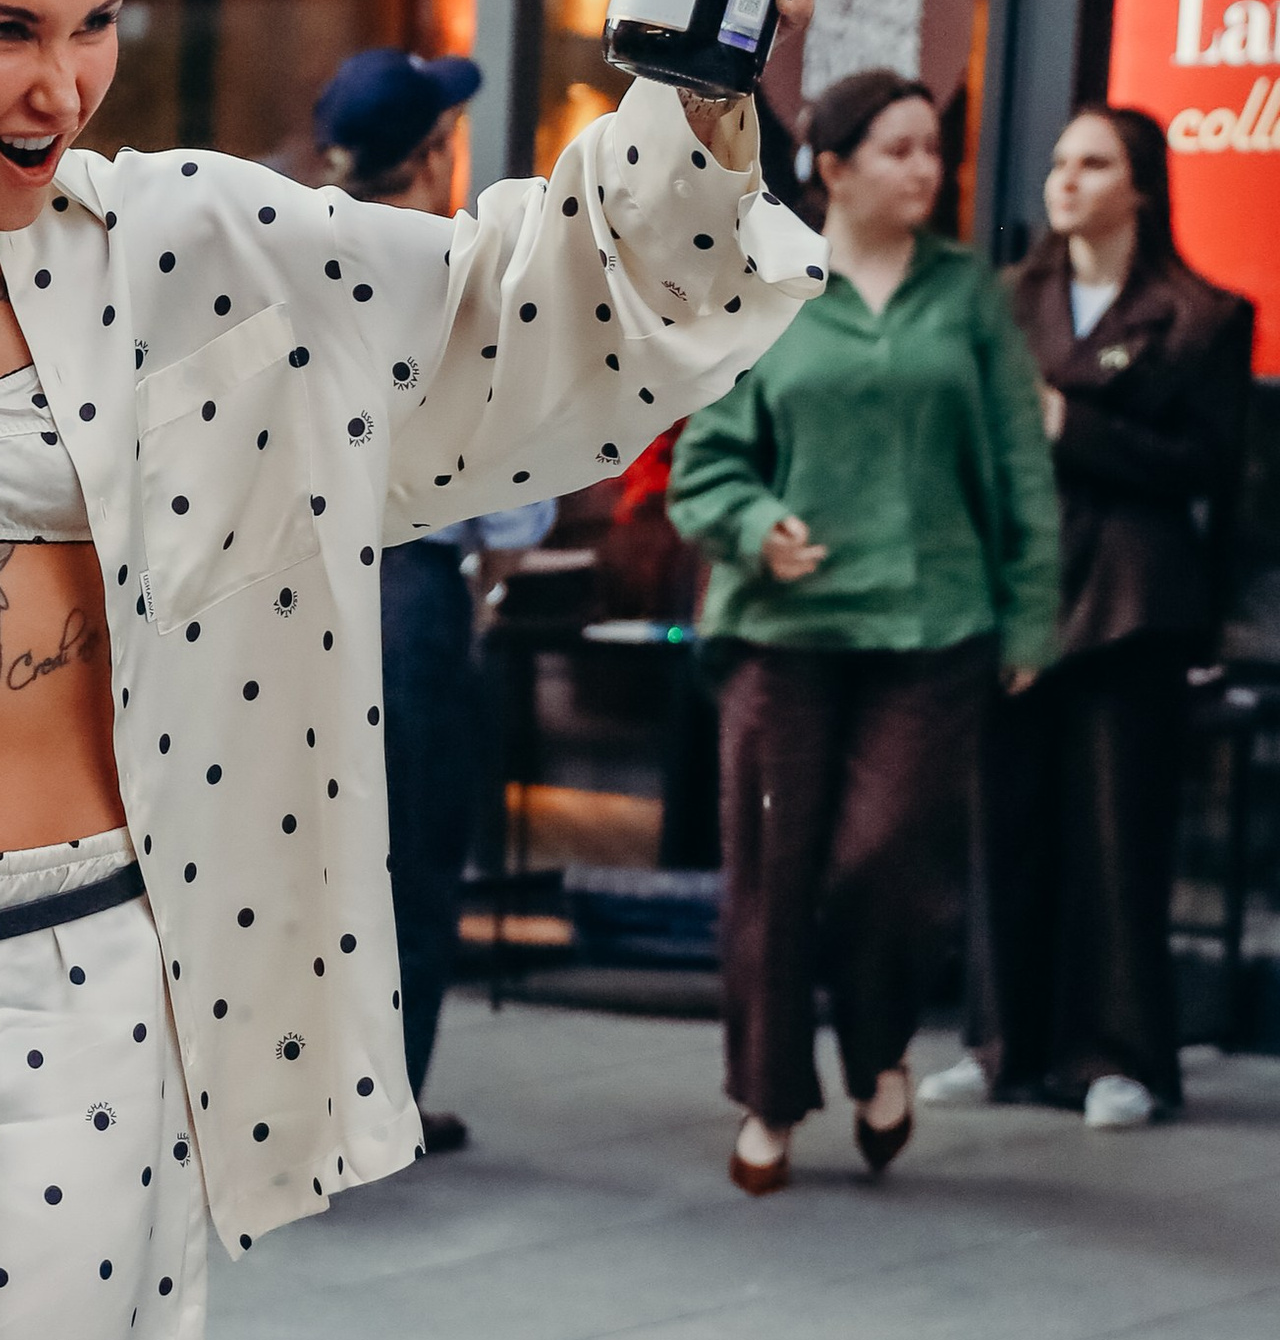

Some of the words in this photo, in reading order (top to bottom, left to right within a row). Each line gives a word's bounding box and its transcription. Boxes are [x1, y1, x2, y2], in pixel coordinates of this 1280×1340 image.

[393, 356, 420, 391] USHATAVA
[349, 410, 375, 447] USHATAVA
[143, 574, 154, 618] USHATAVA
[276, 1031, 306, 1059] USHATAVA
[85, 1101, 116, 1126] USHATAVA
